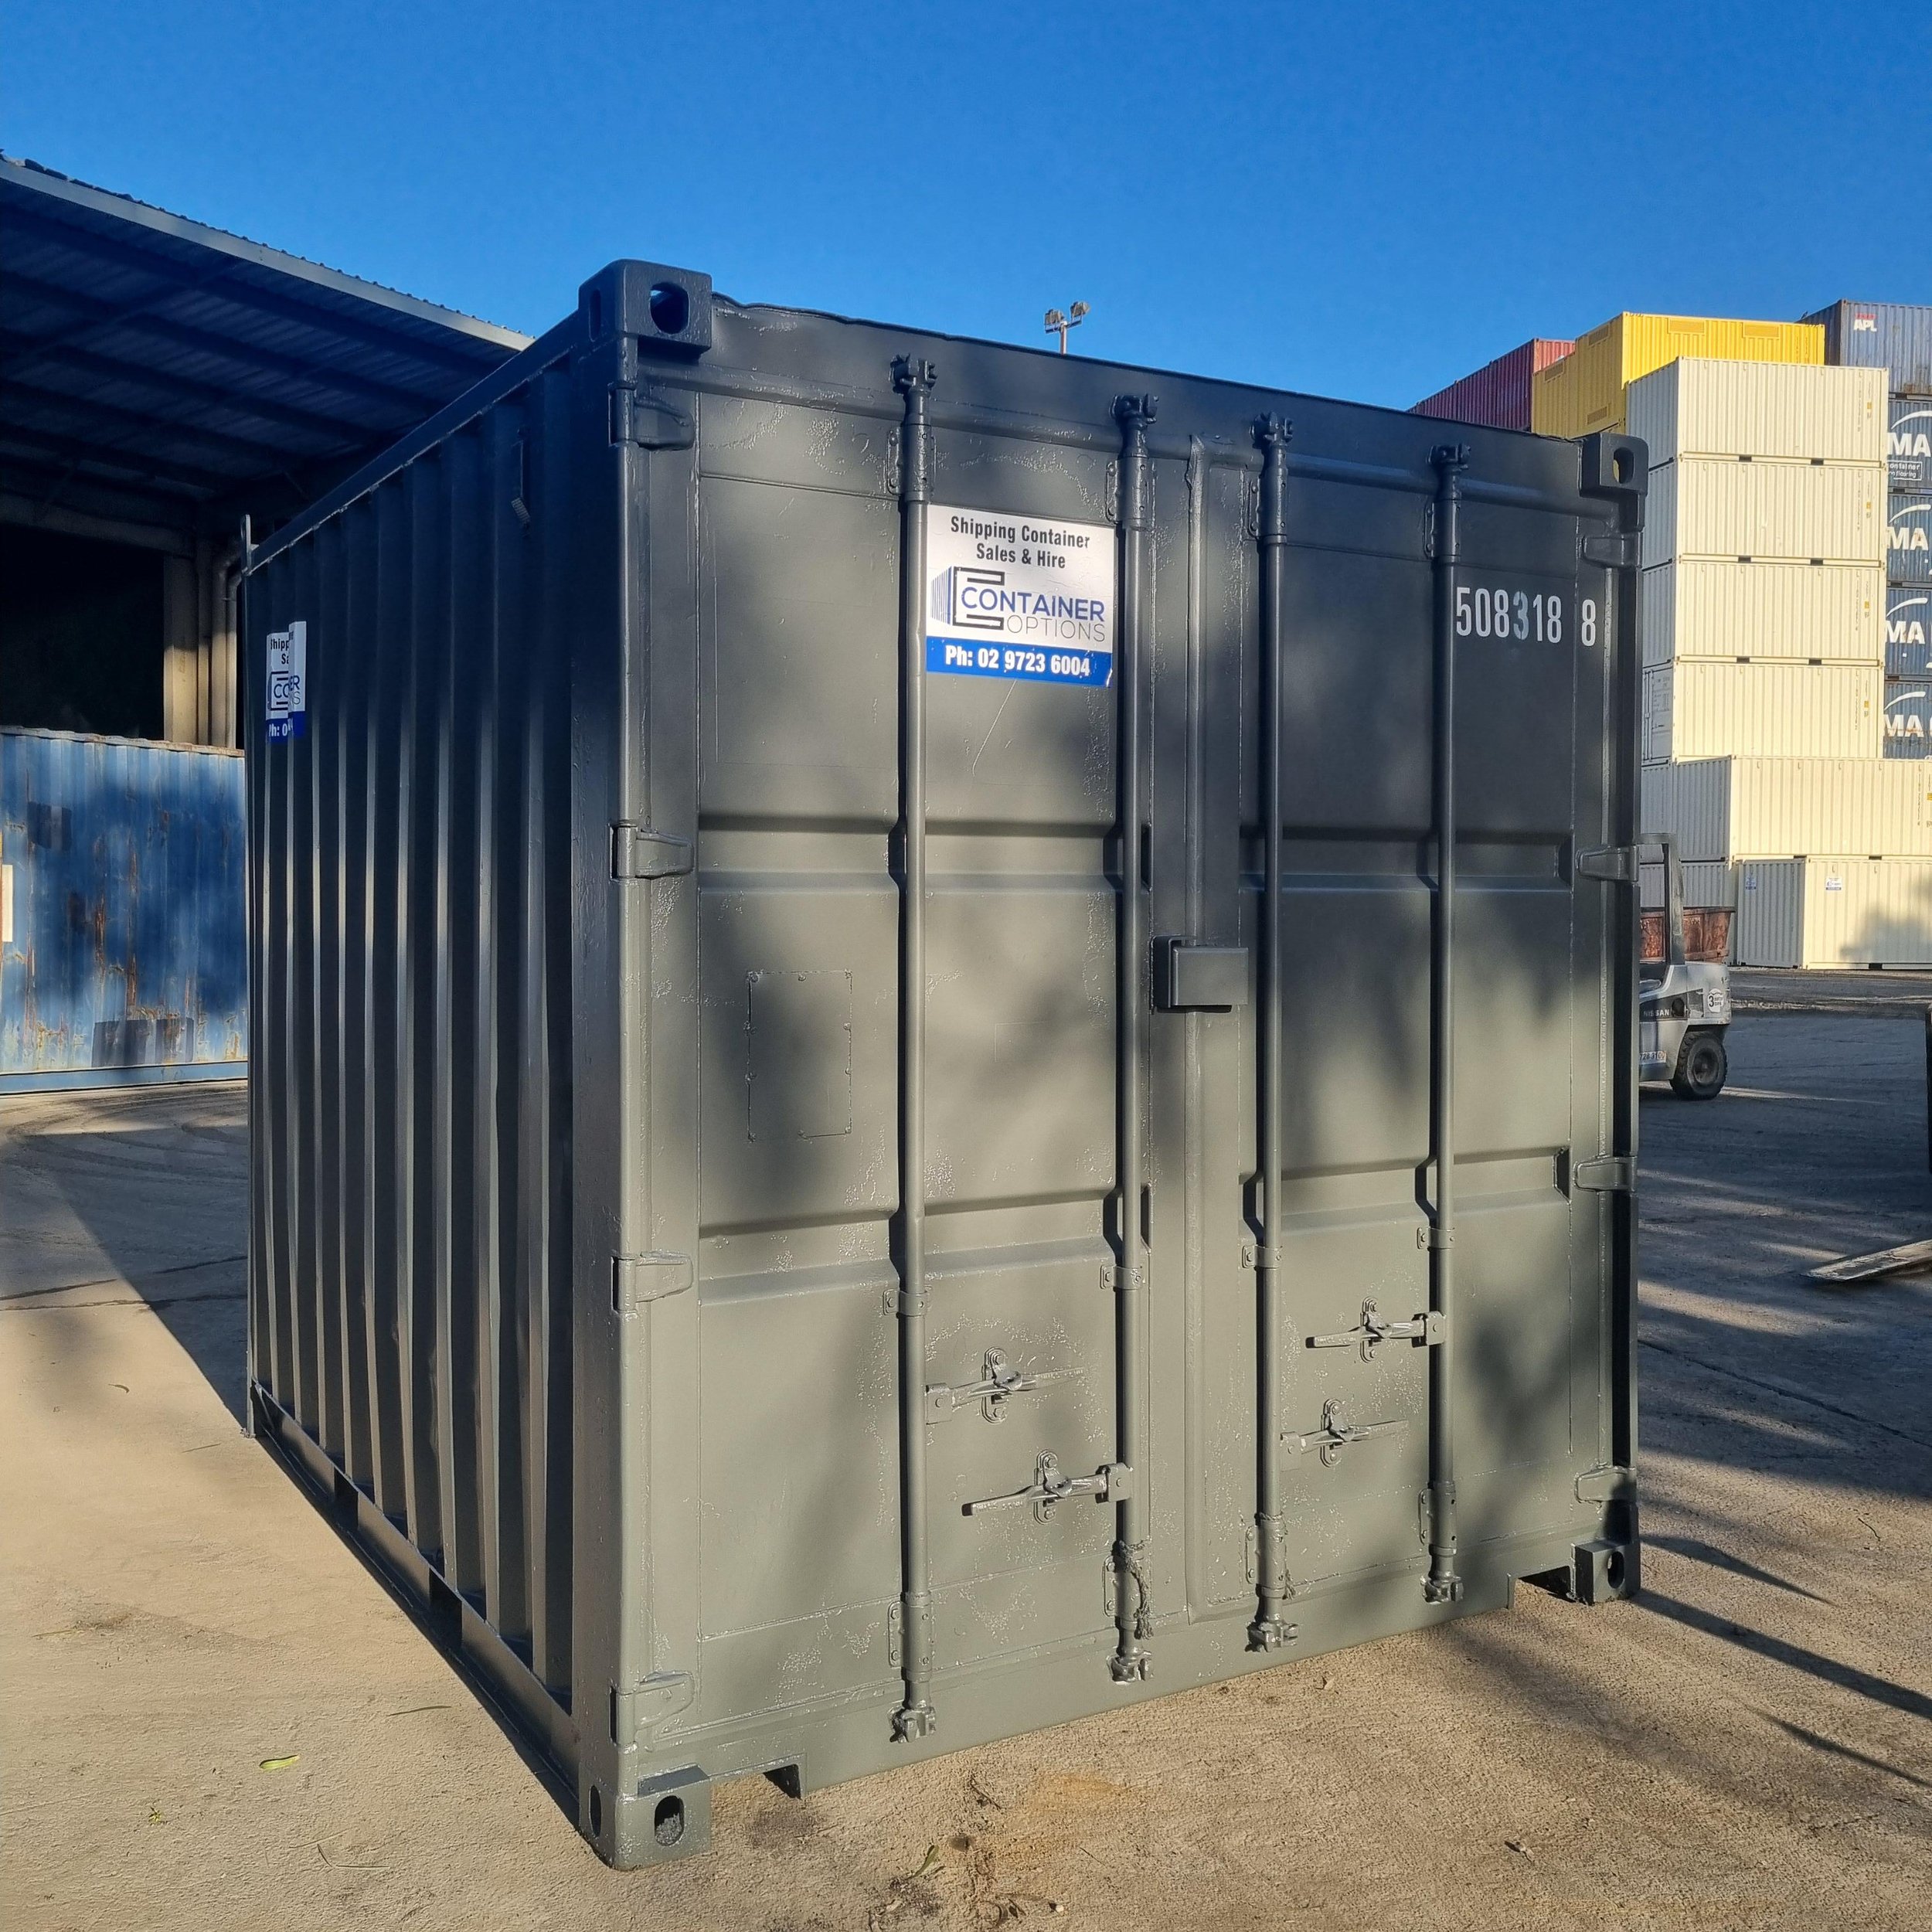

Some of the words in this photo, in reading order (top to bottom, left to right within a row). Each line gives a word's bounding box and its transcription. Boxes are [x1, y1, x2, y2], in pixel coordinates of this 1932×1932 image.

[1853, 318, 1877, 332] APL
[951, 515, 1015, 543] Shipping
[1022, 525, 1090, 549] Container
[976, 543, 1016, 563] Sales
[1021, 548, 1032, 565] &
[1037, 549, 1066, 569] Hire
[961, 587, 1105, 622] CONTAINER
[1456, 587, 1562, 644] 508318
[1581, 599, 1596, 647] 8
[1007, 614, 1105, 642] OPTIONS
[945, 645, 973, 667] Ph:
[978, 648, 998, 668] 02
[1005, 650, 1046, 672] 9723
[1051, 655, 1090, 677] 6004
